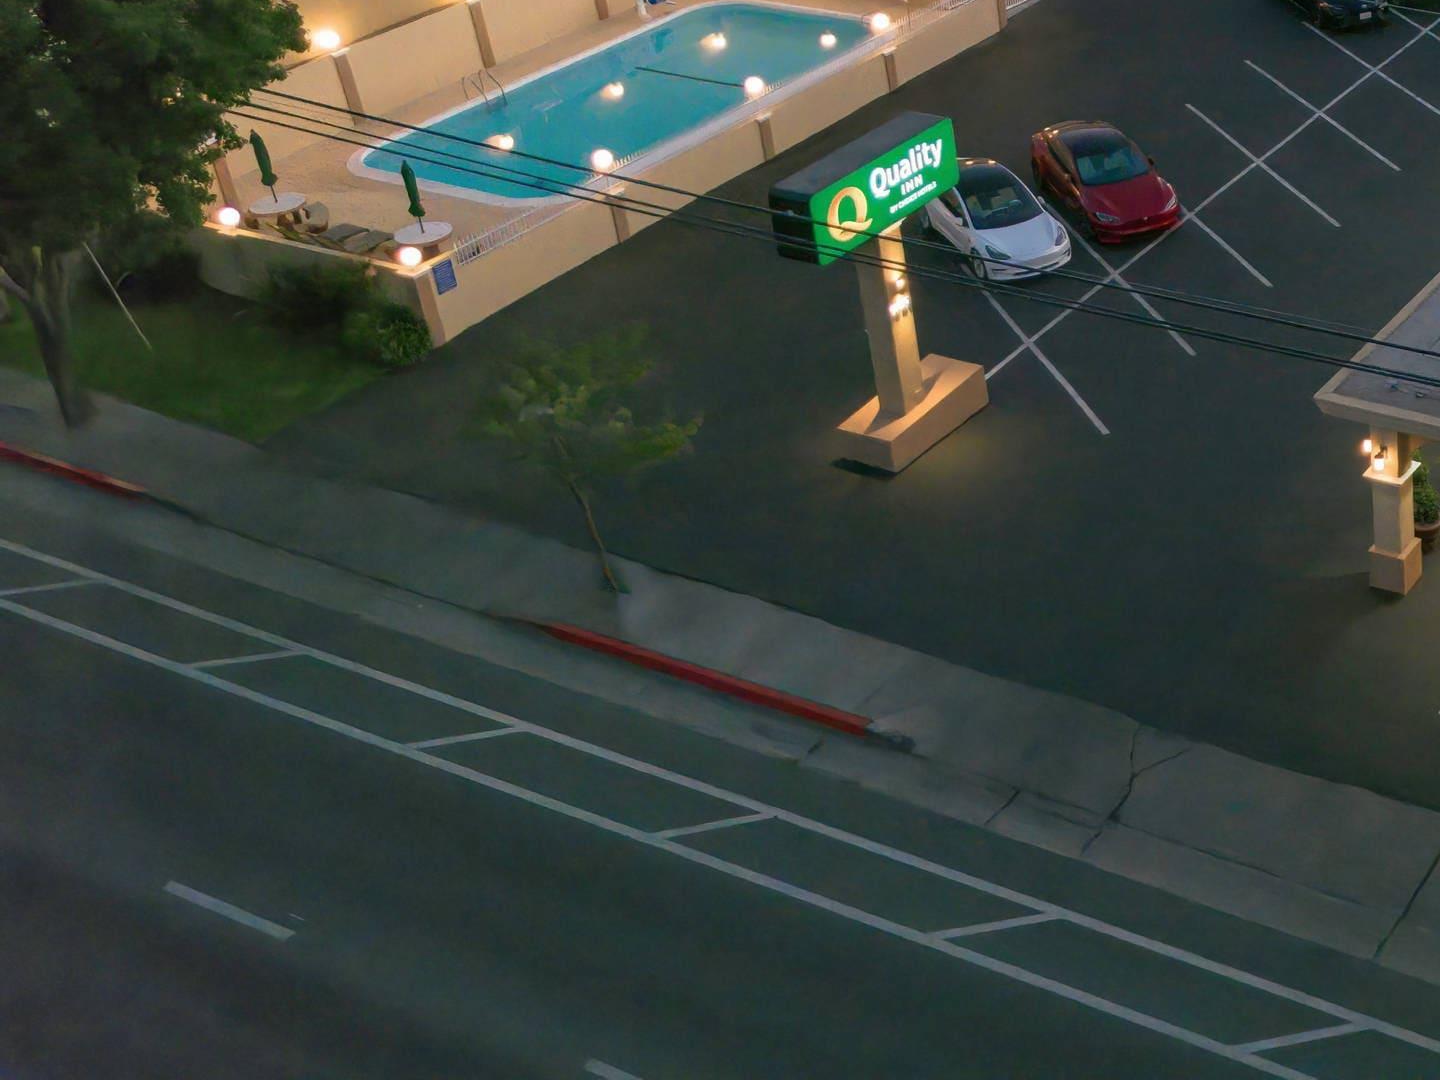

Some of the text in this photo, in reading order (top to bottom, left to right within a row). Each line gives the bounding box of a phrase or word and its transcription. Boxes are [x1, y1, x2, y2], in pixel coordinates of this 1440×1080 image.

[869, 139, 942, 199] Quality
[901, 174, 923, 195] INN
[828, 186, 872, 242] Q
